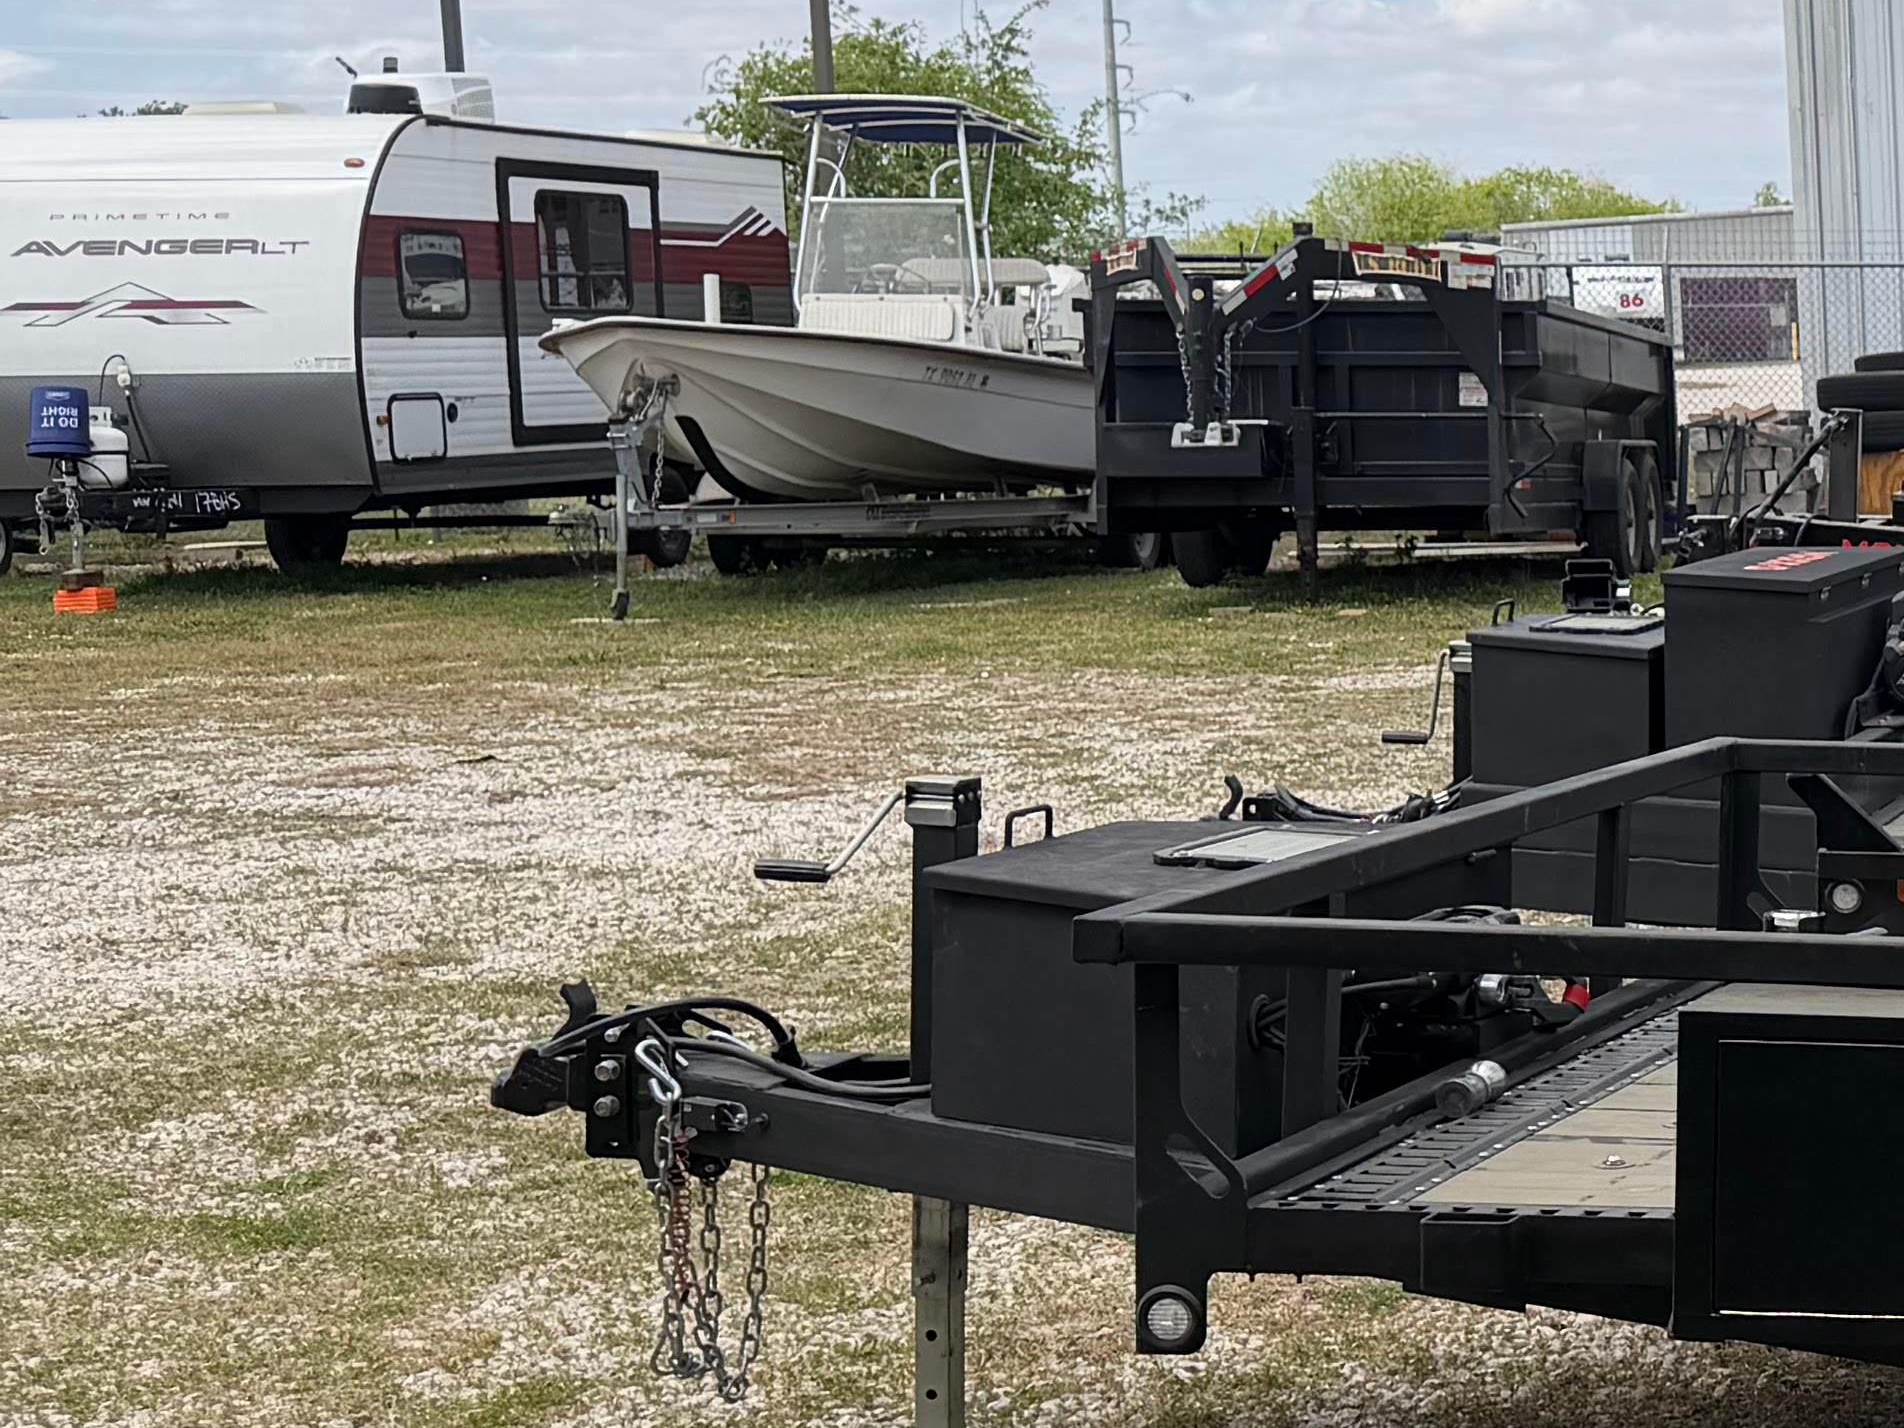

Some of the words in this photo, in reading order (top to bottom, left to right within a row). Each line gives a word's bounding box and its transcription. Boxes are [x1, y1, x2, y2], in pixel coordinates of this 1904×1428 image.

[1620, 293, 1645, 308] 86
[40, 405, 78, 416] RIGHT
[40, 415, 54, 427] IT
[57, 416, 78, 428] DO
